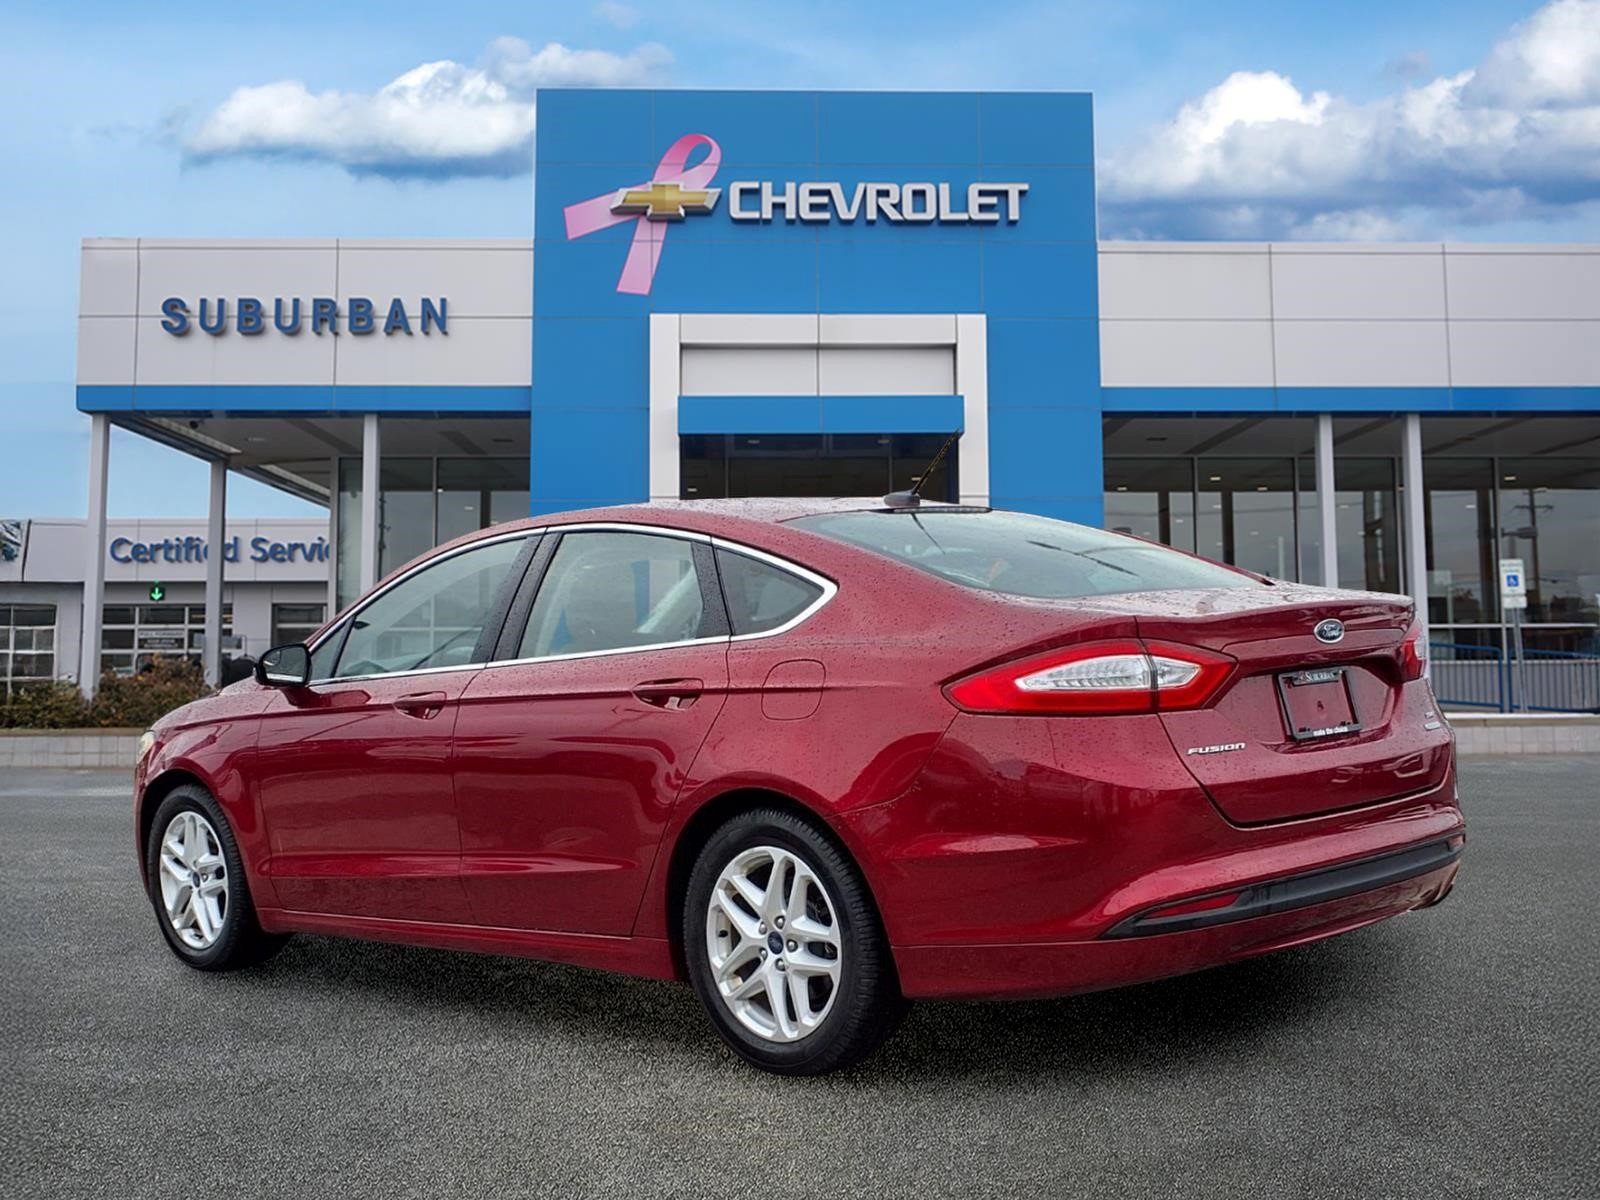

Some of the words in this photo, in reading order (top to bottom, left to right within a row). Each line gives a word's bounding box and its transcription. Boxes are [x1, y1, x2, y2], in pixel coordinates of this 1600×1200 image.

[728, 181, 1030, 222] CHEVROLET
[161, 297, 448, 335] SUBURBAN
[110, 536, 240, 563] Certifid
[250, 536, 330, 563] Servi
[1187, 742, 1246, 755] FUSION
